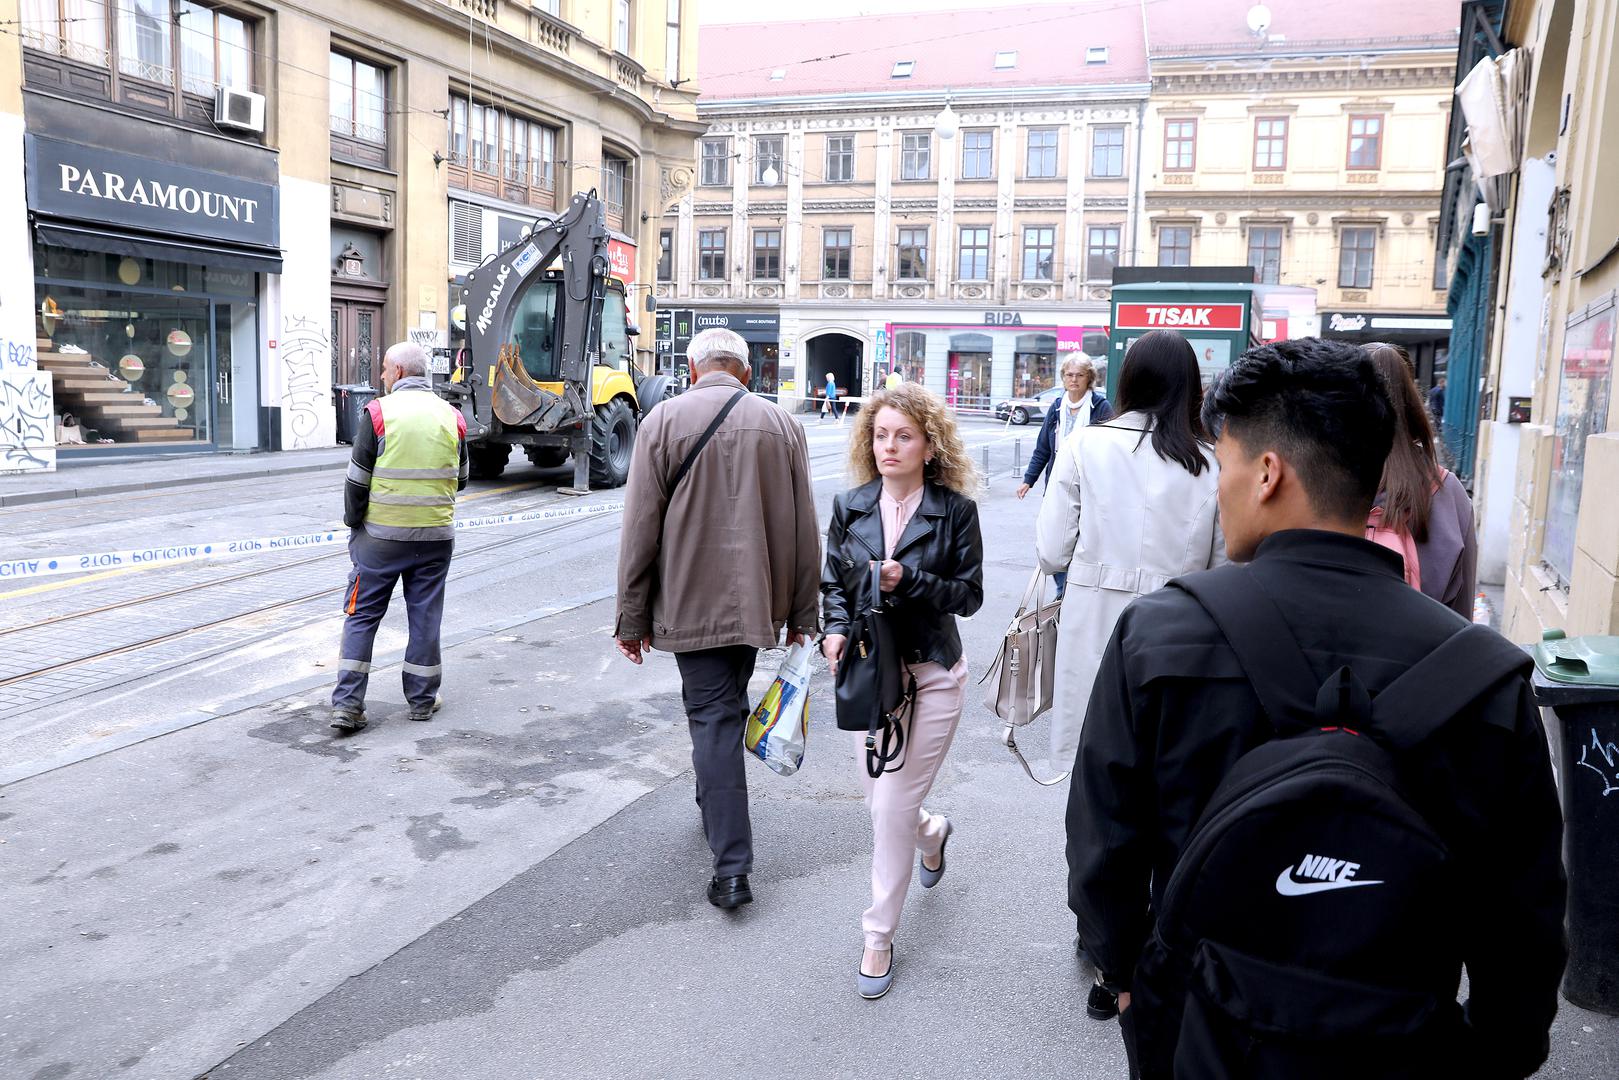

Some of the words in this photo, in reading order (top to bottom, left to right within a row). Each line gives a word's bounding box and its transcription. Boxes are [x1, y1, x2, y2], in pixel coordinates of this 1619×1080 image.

[58, 163, 258, 224] PARAMOUNT
[697, 315, 729, 327] (nuts)
[984, 312, 1023, 326] BIPA
[1146, 307, 1212, 325] TISAK
[1057, 341, 1081, 350] BIPA
[1296, 853, 1361, 883] NIKE
